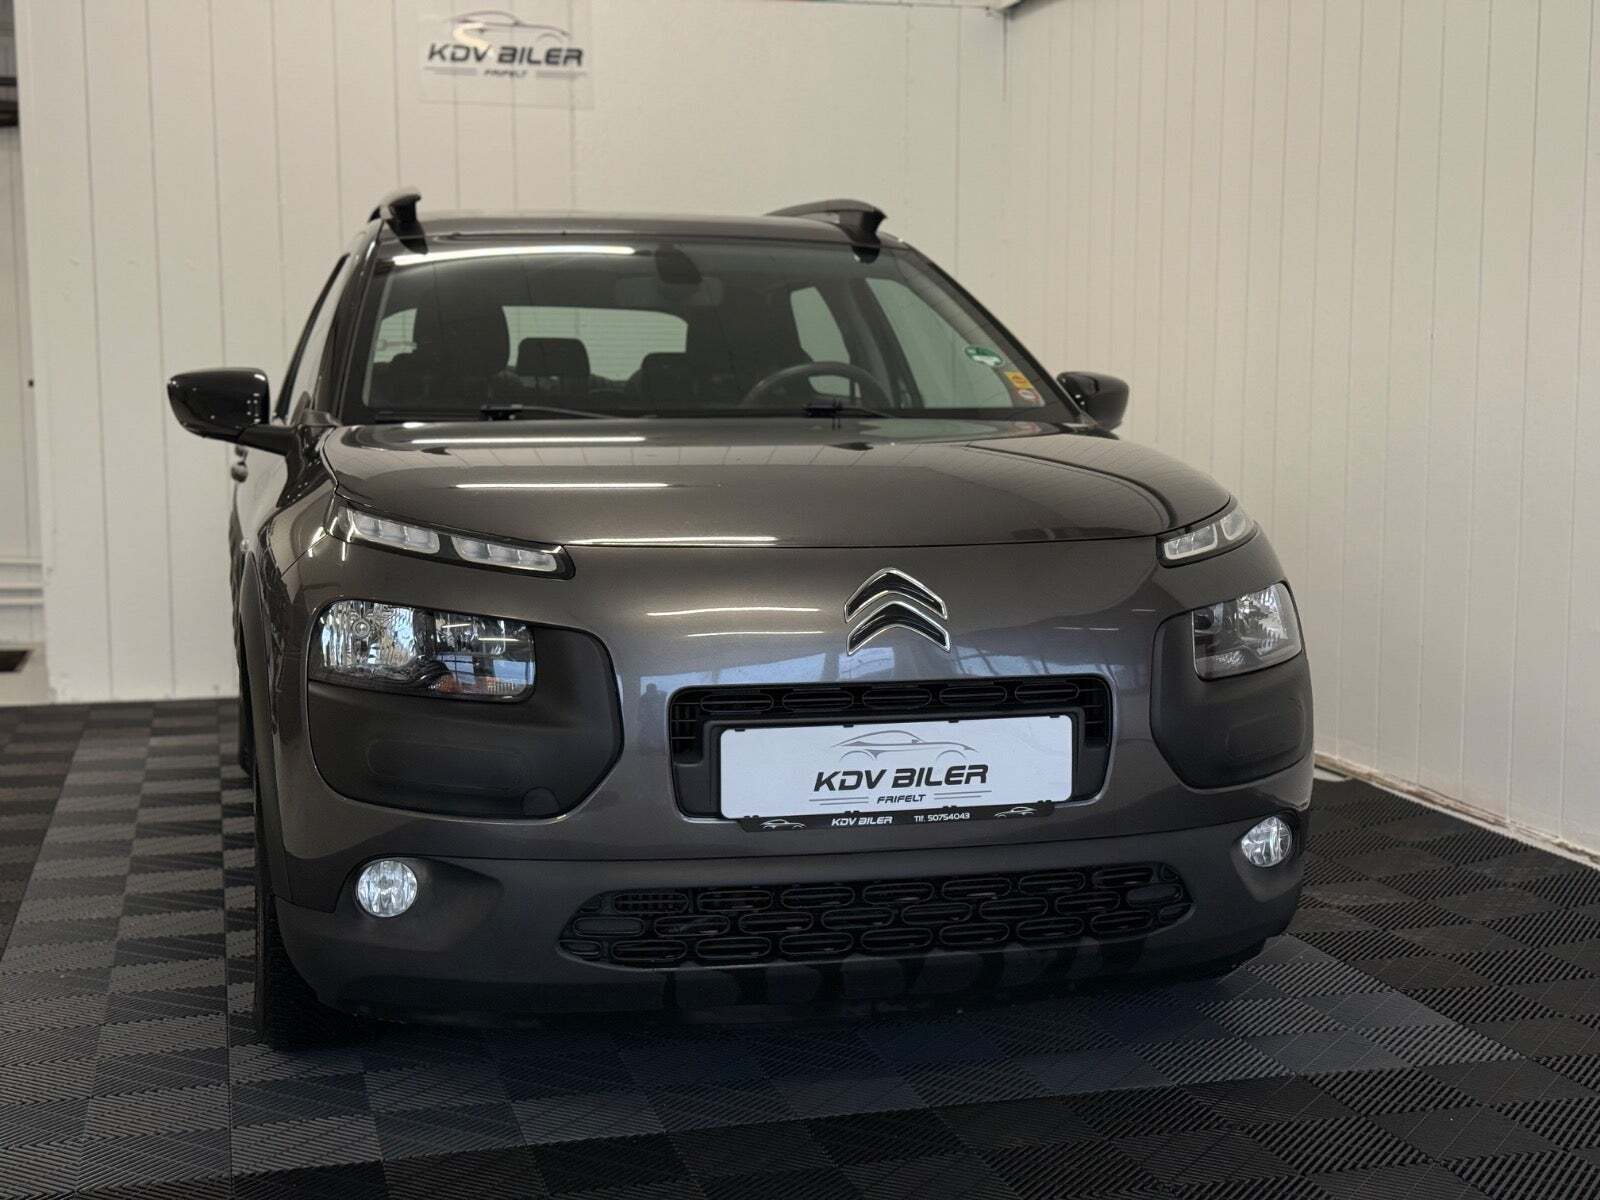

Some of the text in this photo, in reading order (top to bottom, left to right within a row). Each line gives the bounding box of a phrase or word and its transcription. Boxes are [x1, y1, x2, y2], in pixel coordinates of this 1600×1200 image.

[428, 44, 584, 66] KDV BILER
[813, 764, 988, 792] KDV BILER
[876, 794, 926, 804] FRIFELT
[831, 817, 858, 827] KDV
[858, 816, 893, 826] BILER
[927, 812, 970, 822] 50754043
